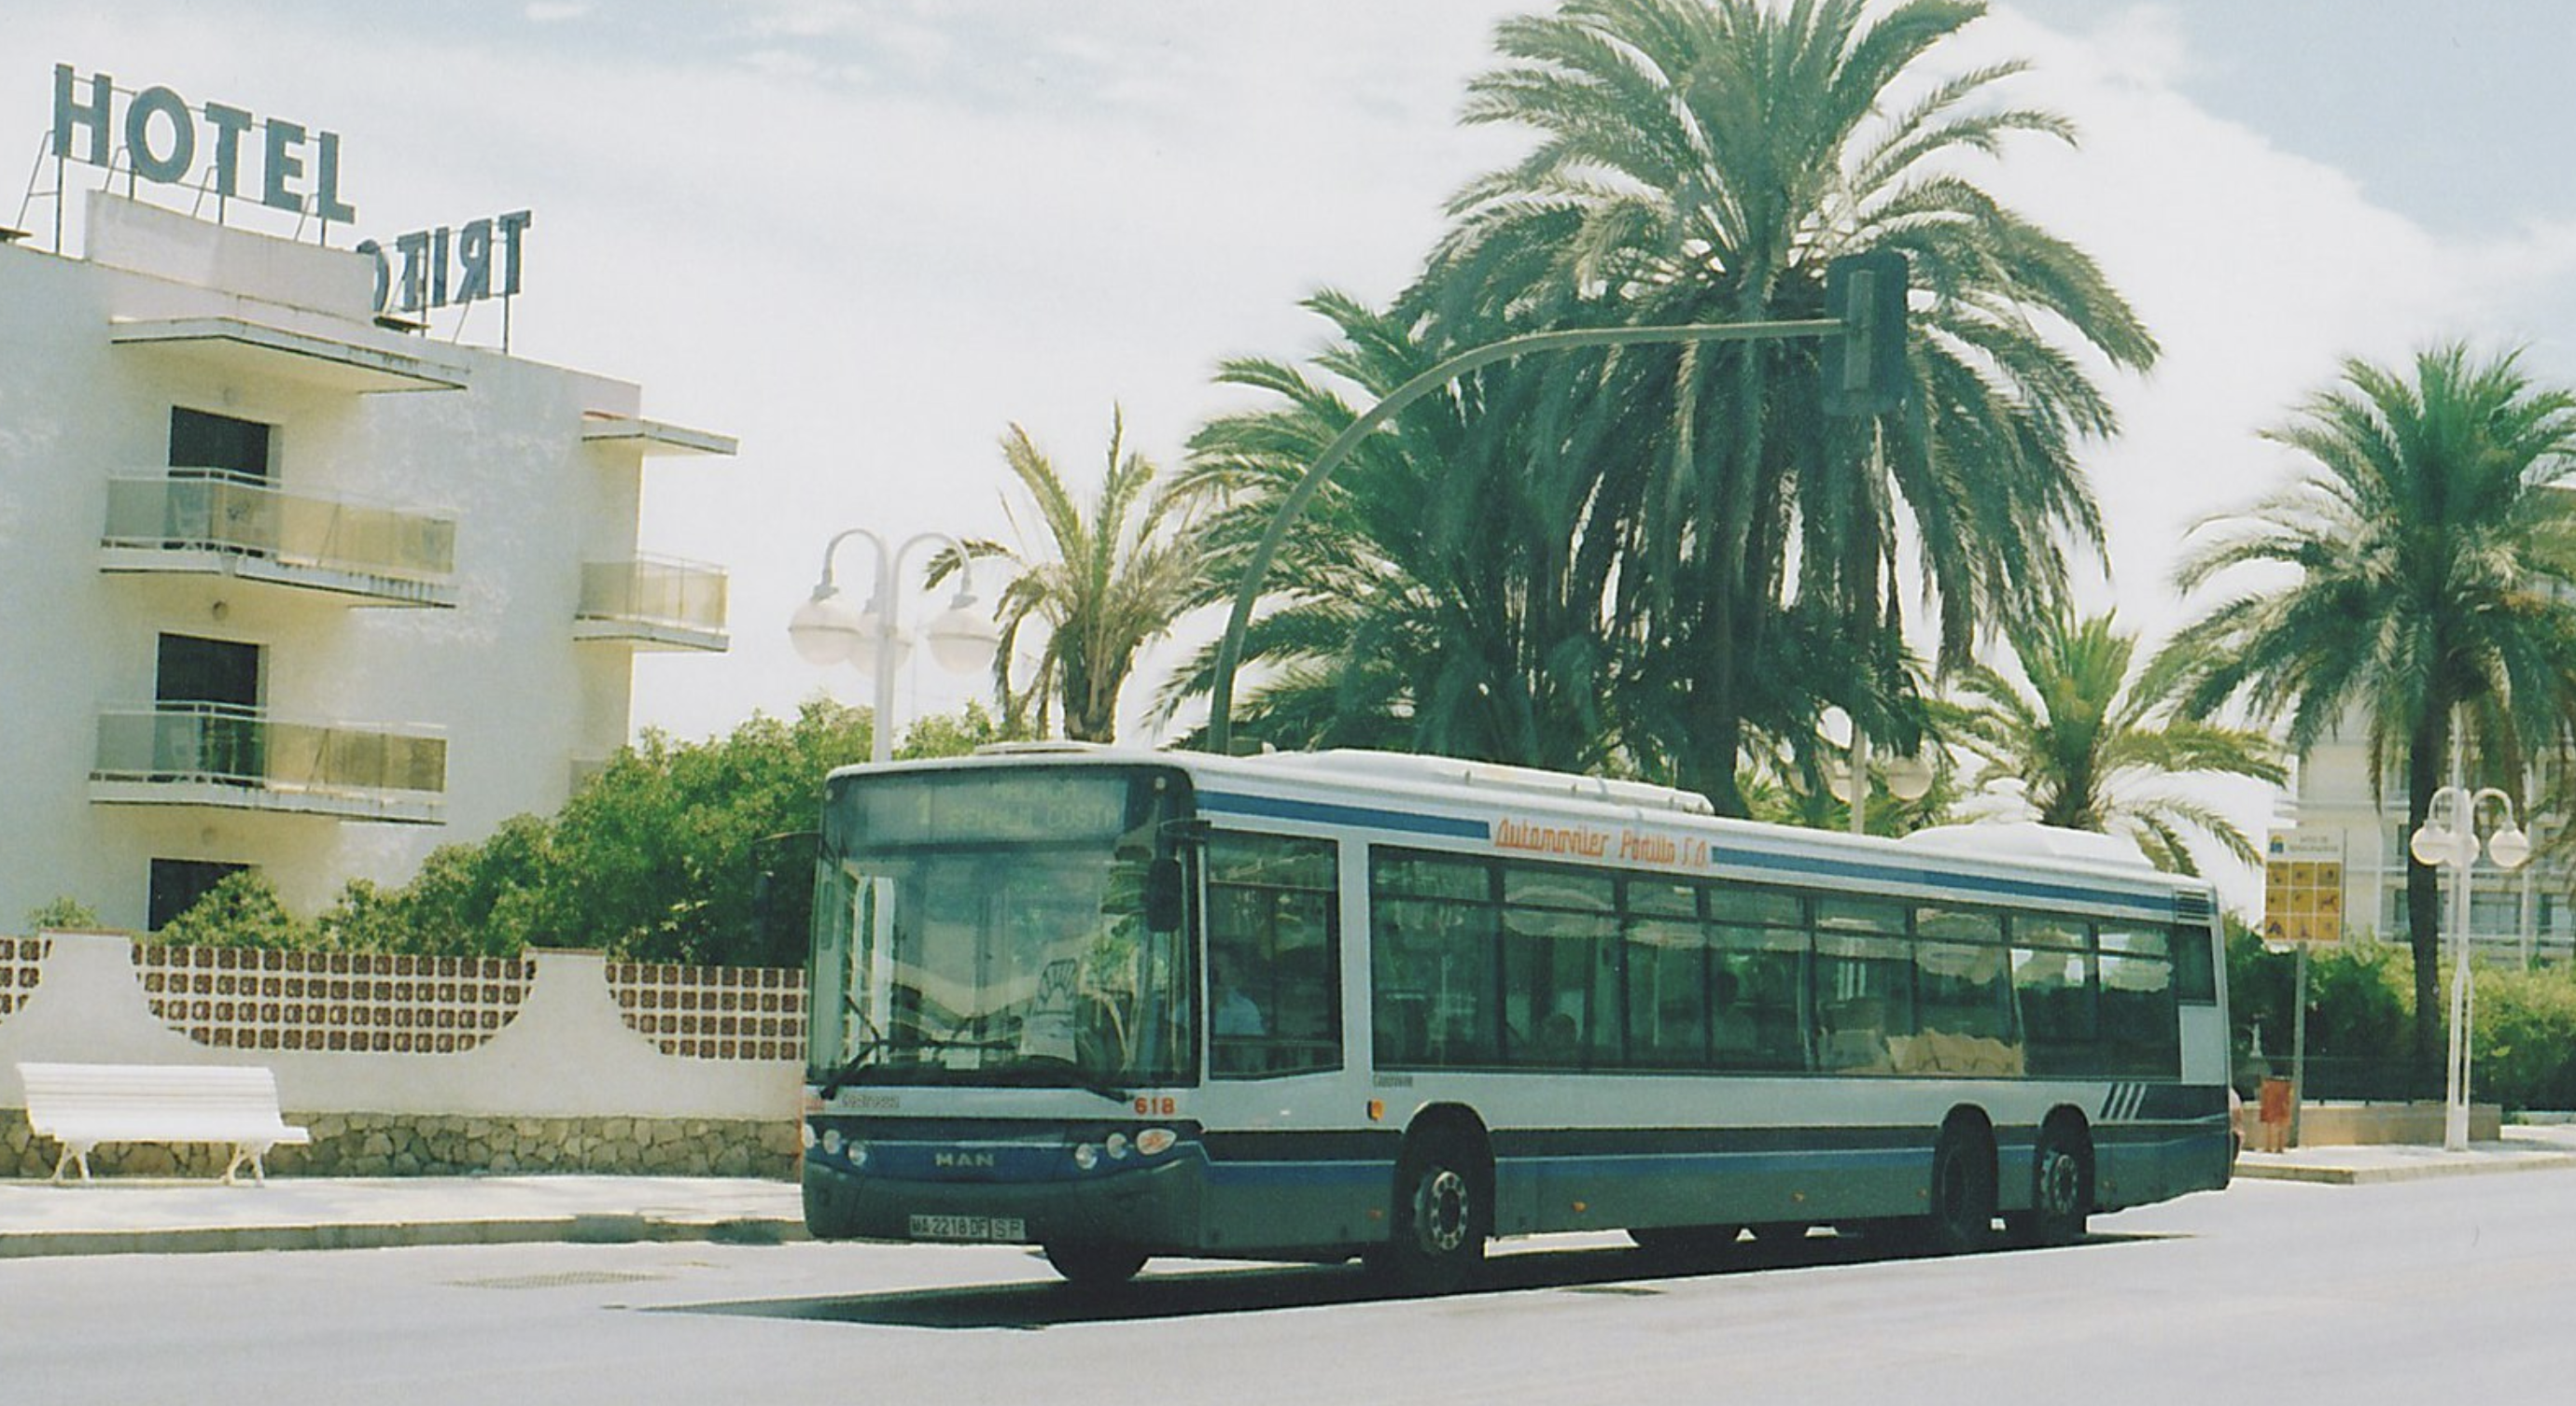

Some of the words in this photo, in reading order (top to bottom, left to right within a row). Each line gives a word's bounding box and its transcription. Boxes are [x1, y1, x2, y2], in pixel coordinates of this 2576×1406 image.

[53, 63, 355, 225] HOTEL
[1135, 1096, 1175, 1115] 618
[936, 1152, 994, 1167] MAN
